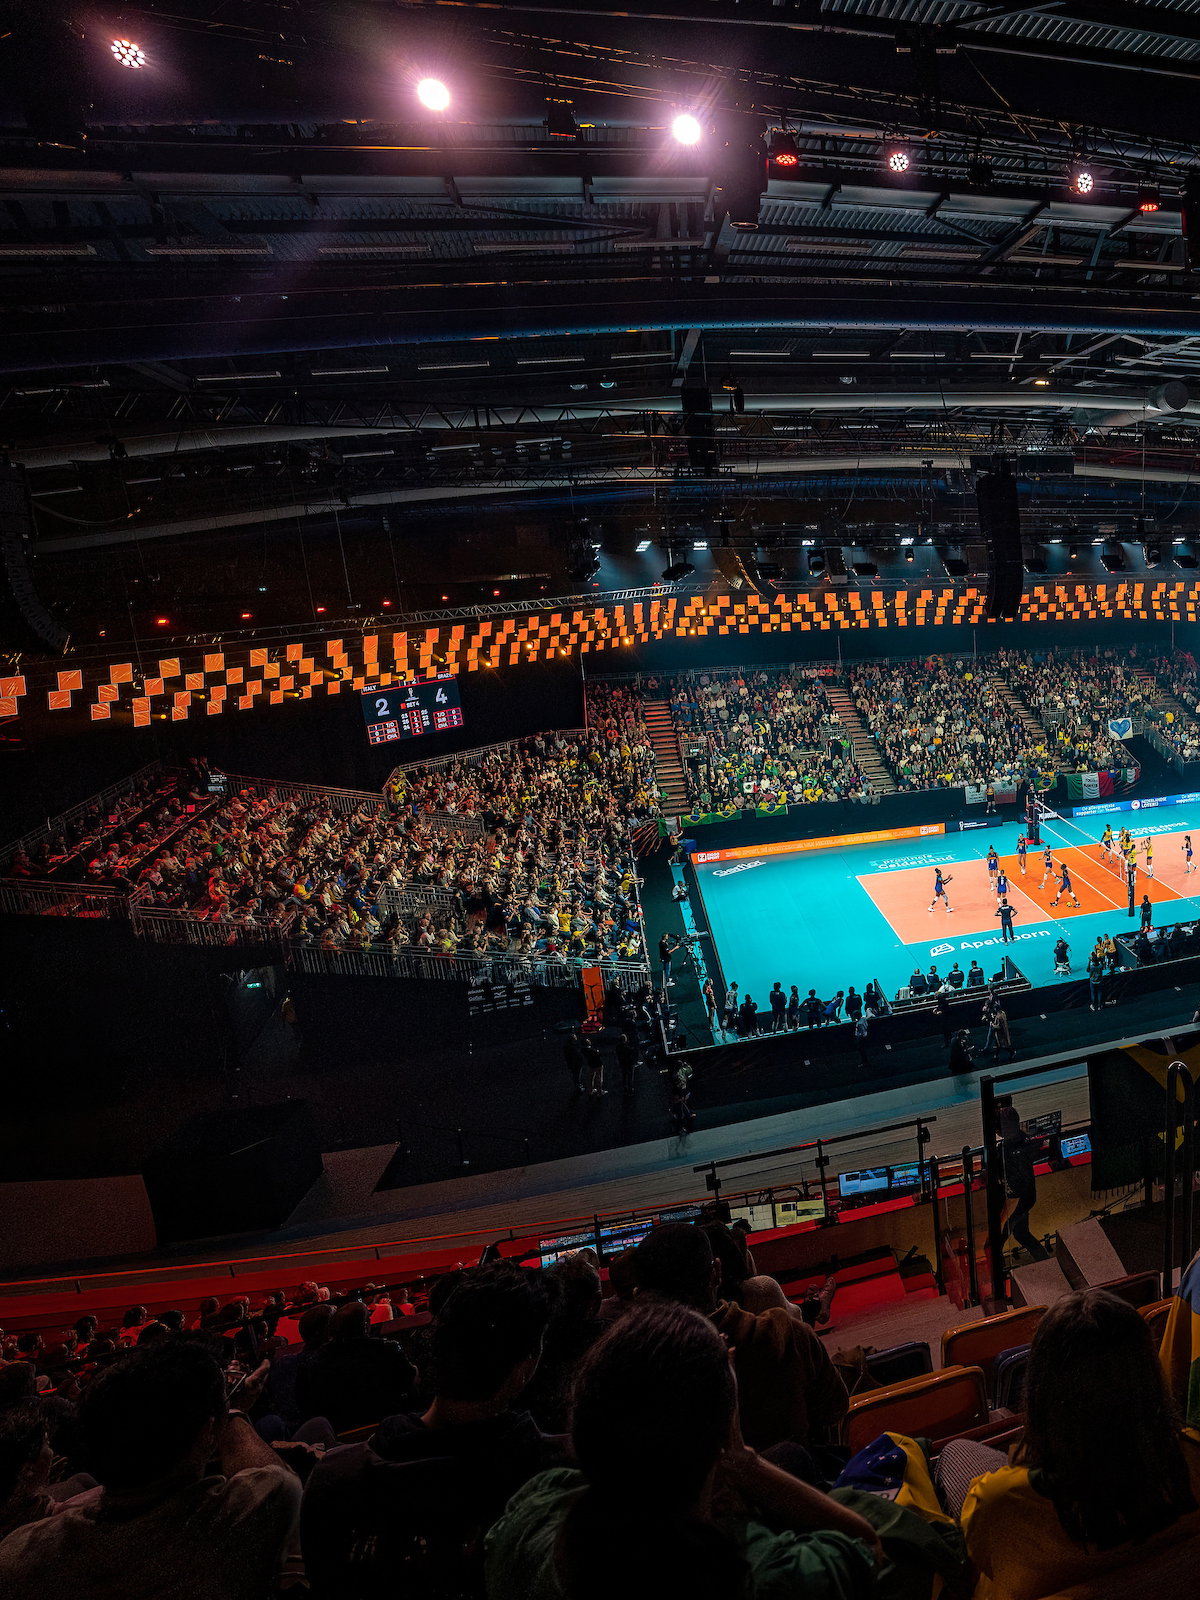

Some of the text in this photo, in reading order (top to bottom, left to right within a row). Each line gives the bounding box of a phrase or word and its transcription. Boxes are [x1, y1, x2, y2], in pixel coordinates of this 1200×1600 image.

[435, 688, 448, 704] 4
[375, 698, 390, 716] 2
[878, 855, 955, 869] Gelderland
[883, 854, 933, 865] Provincie
[713, 860, 767, 877] Gerflor
